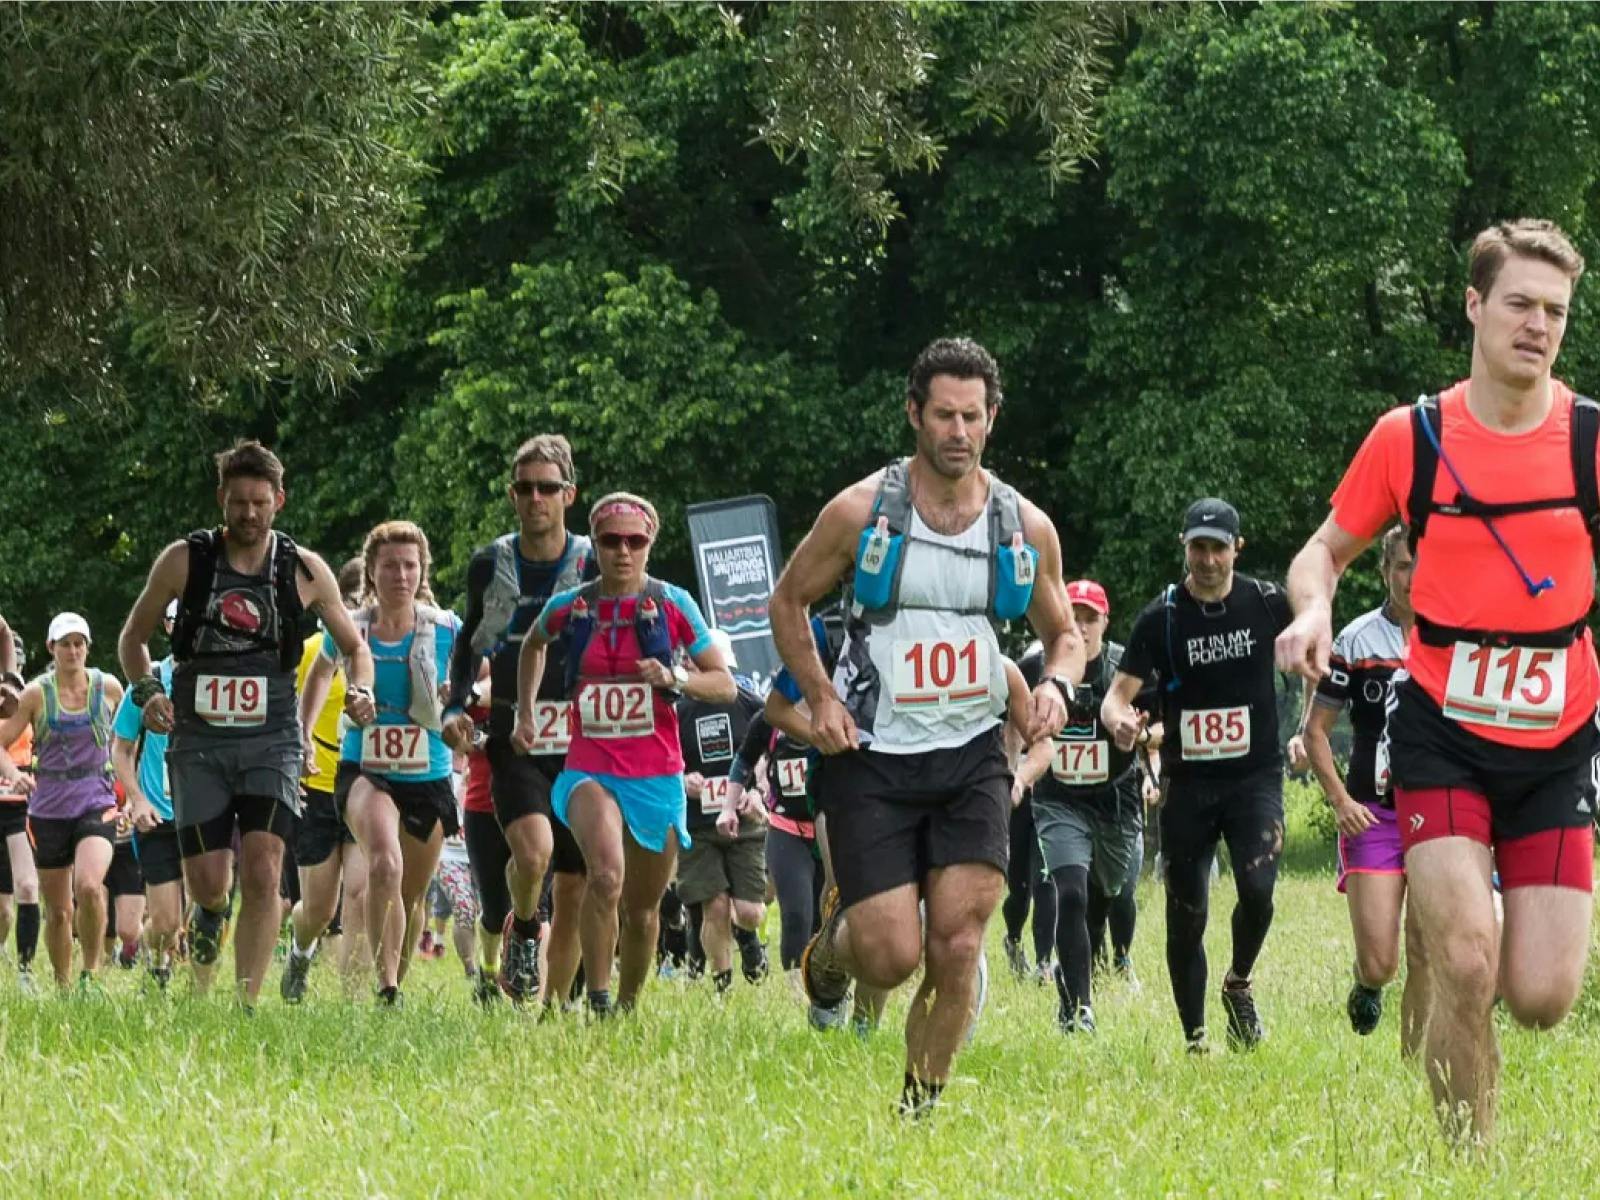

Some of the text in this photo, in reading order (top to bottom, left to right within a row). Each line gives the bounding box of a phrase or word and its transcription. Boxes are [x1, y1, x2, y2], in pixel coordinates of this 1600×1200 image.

[1187, 627, 1251, 654] PT IN MY
[1189, 639, 1257, 667] POCKET
[904, 639, 978, 689] 101
[1468, 646, 1555, 705] 115
[205, 677, 260, 713] 119
[587, 686, 647, 722] 102
[539, 702, 573, 738] 21
[1186, 711, 1245, 745] 185
[368, 726, 421, 759] 187
[1057, 743, 1099, 771] 171
[705, 779, 728, 801] 14
[783, 760, 806, 788] 11
